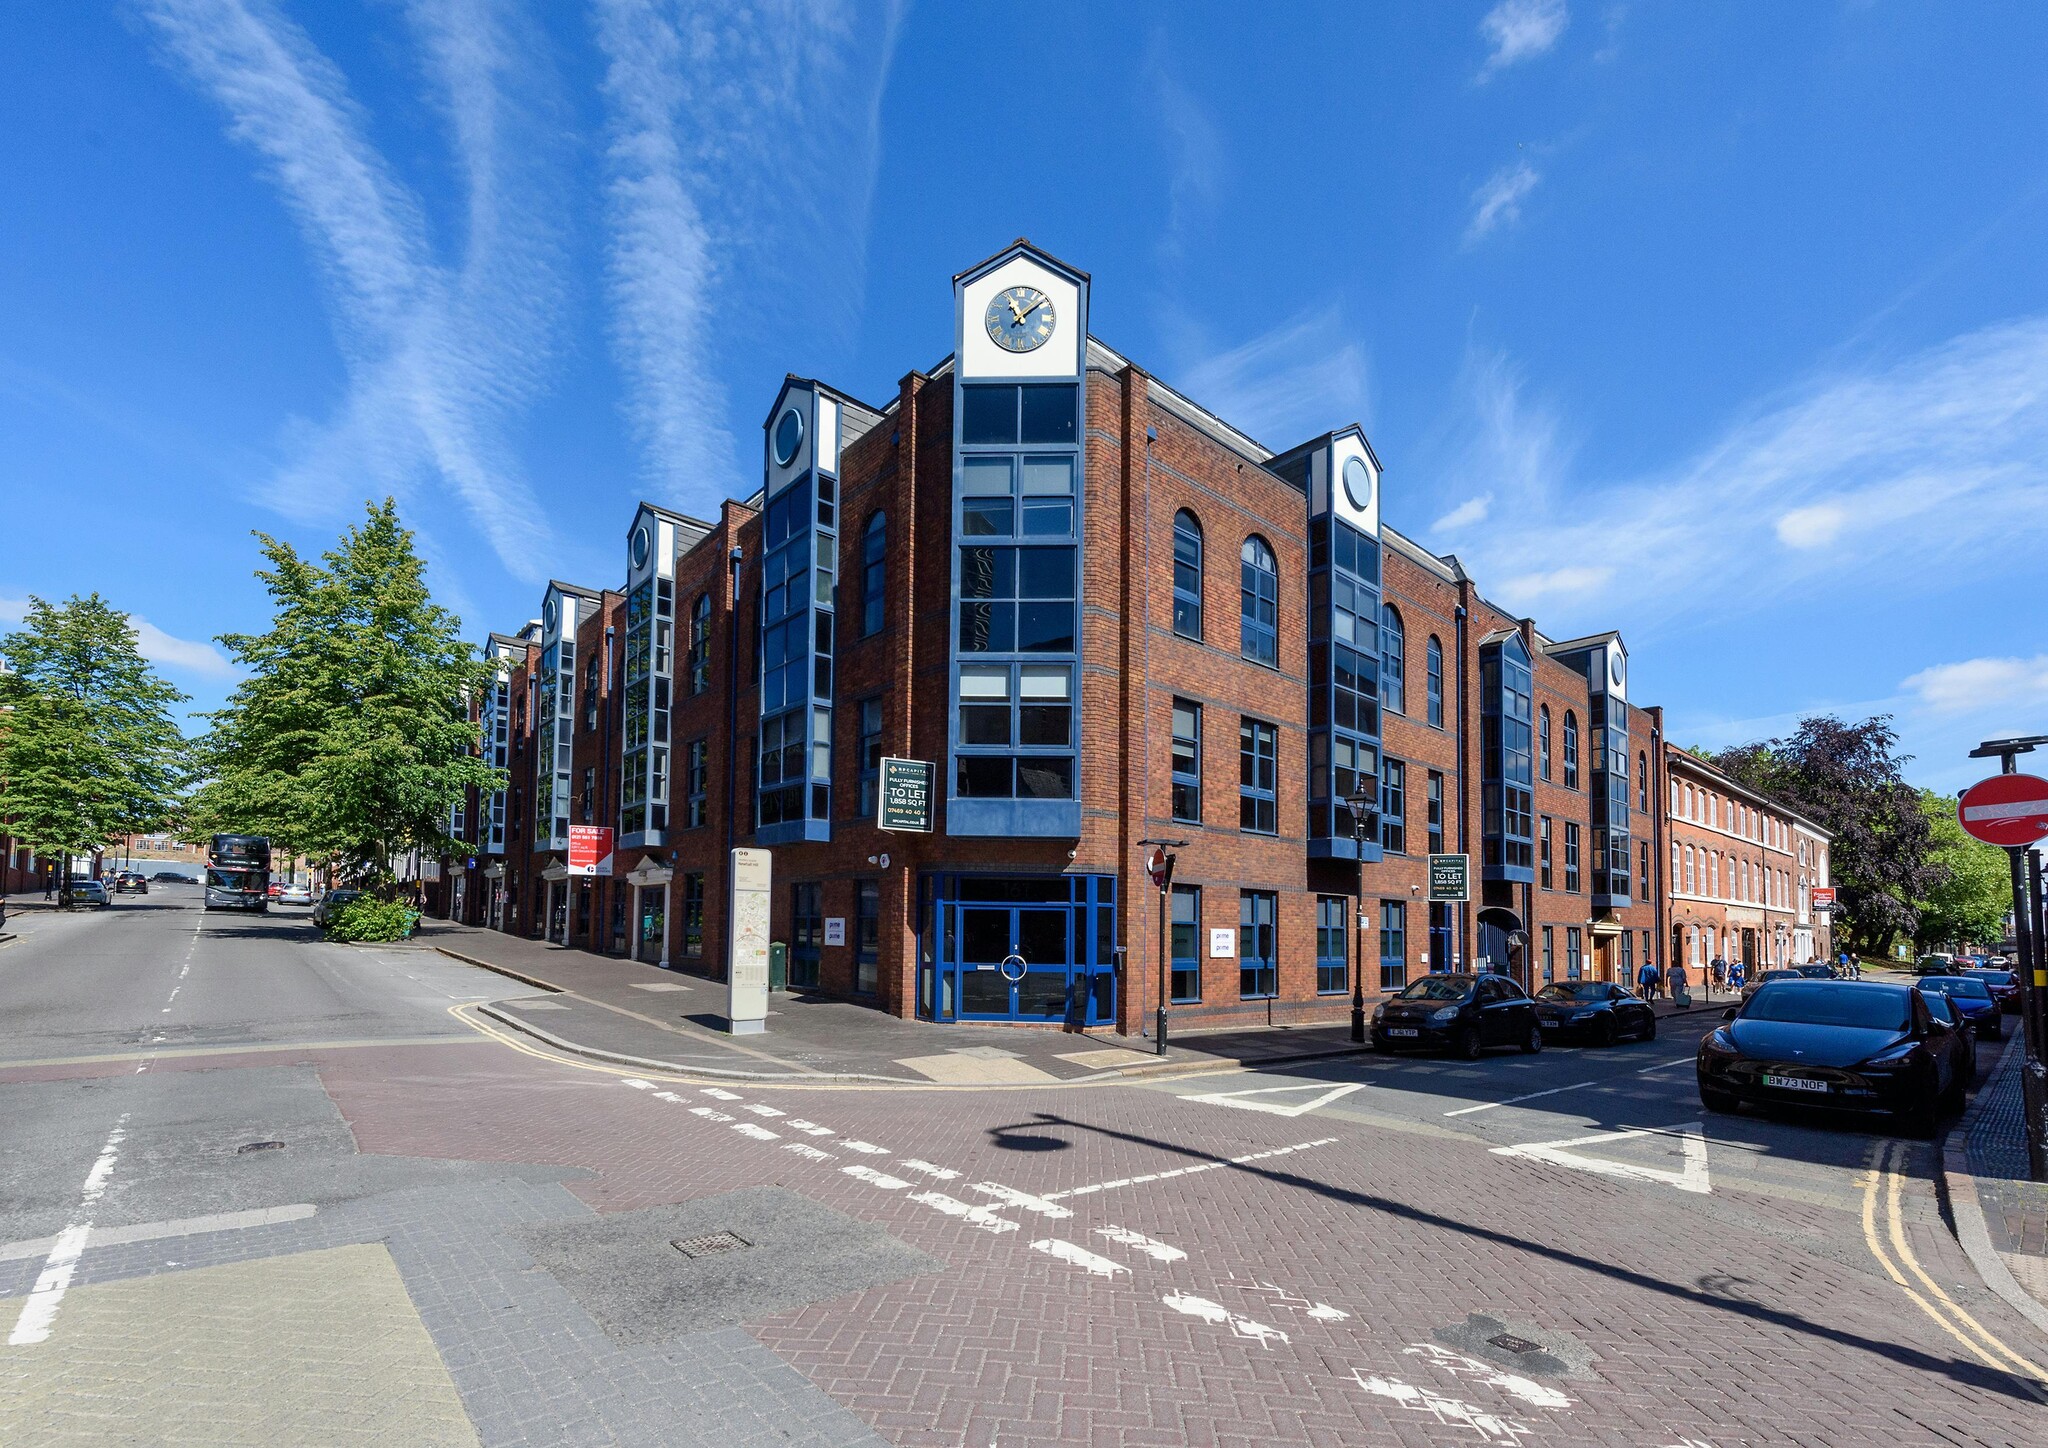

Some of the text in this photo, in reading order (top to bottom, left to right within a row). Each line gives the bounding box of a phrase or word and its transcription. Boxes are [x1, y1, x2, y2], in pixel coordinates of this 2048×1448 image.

[890, 788, 927, 799] TO LET
[1801, 1079, 1824, 1090] NOF
